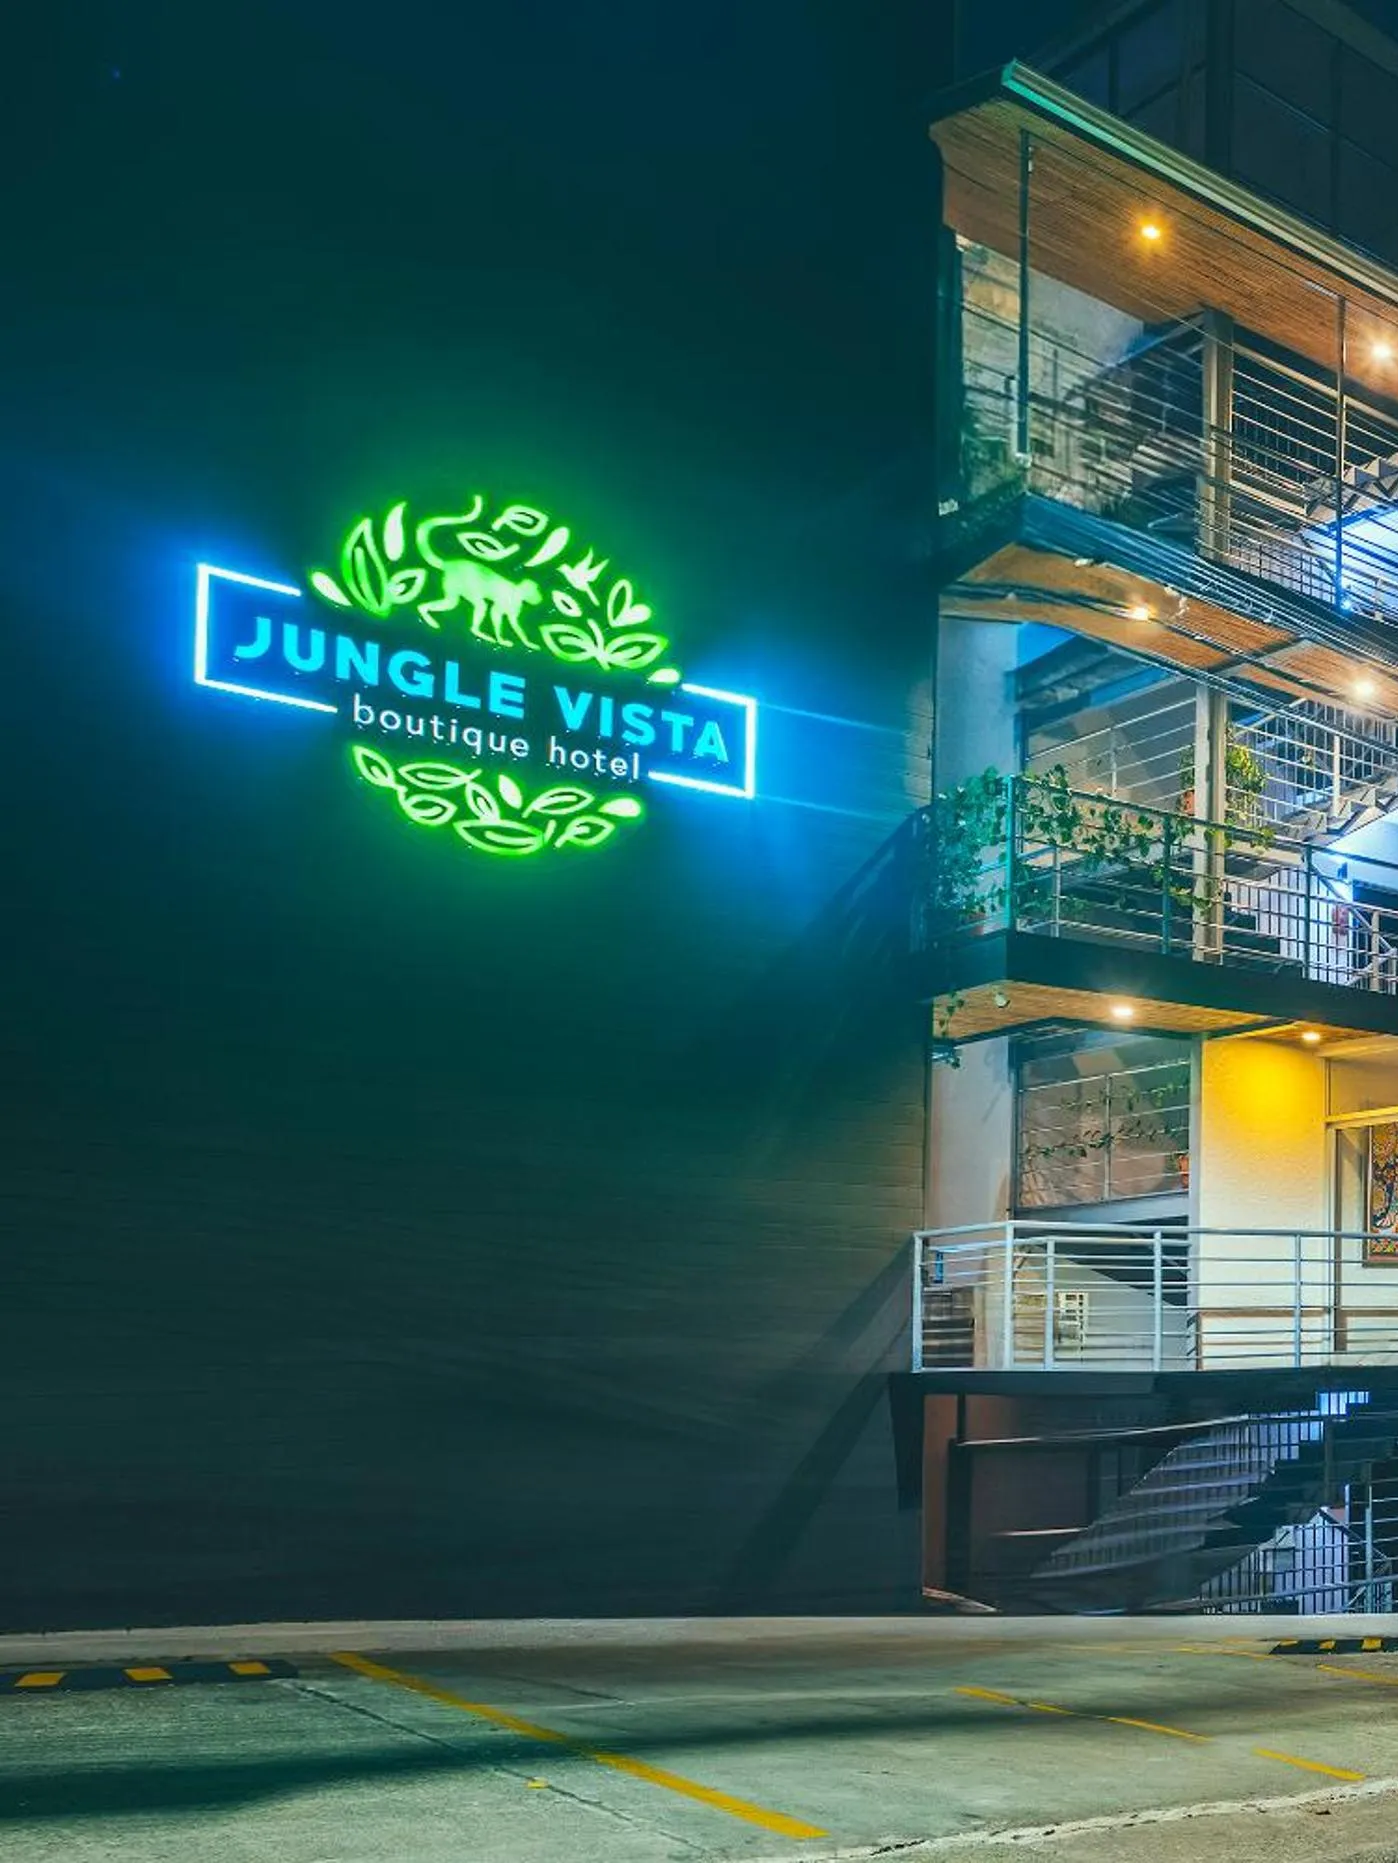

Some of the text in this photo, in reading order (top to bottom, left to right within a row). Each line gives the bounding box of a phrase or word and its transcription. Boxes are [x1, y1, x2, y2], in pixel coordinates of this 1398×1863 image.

[234, 616, 730, 763] JUNGLE VISTA
[352, 693, 642, 780] boutique hotel
